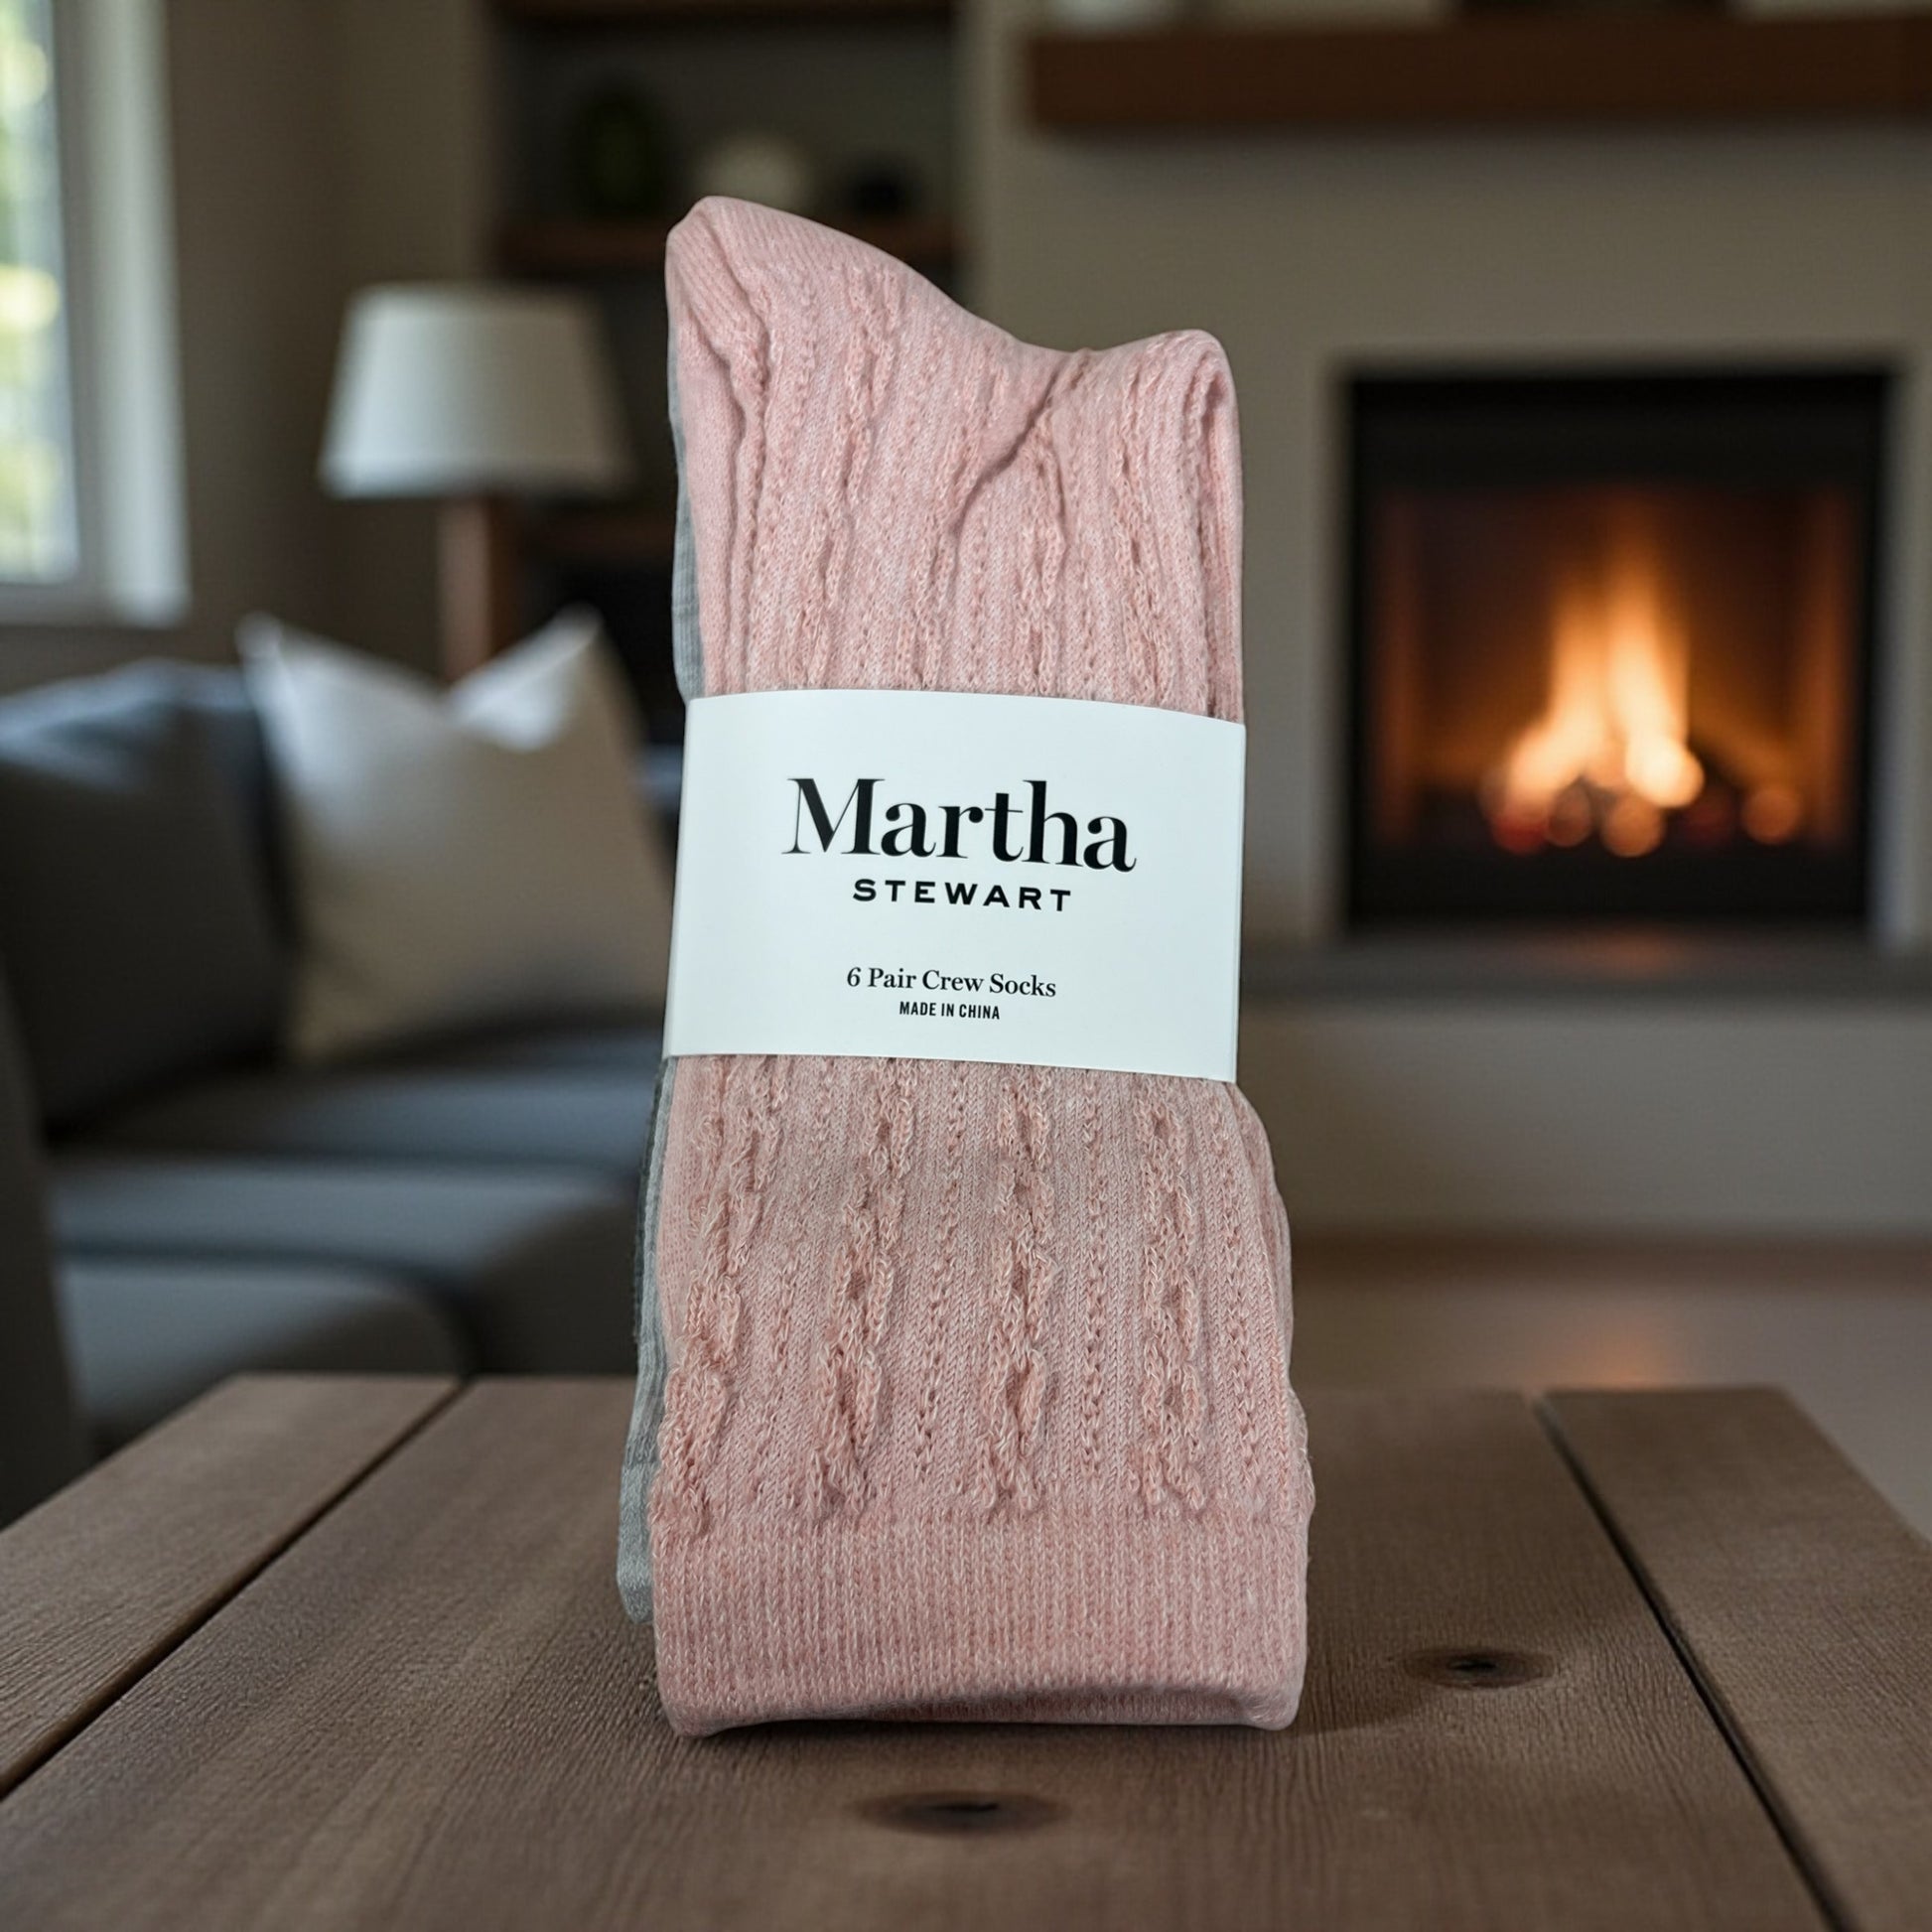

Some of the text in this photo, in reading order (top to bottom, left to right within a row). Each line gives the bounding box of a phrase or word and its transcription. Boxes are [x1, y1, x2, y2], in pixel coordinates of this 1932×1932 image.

[781, 777, 1137, 873] Martha
[852, 878, 1071, 912] STEWART
[847, 966, 1056, 997] 6 Pair Crew Socks
[898, 1001, 1000, 1021] MADE IN CHINA
